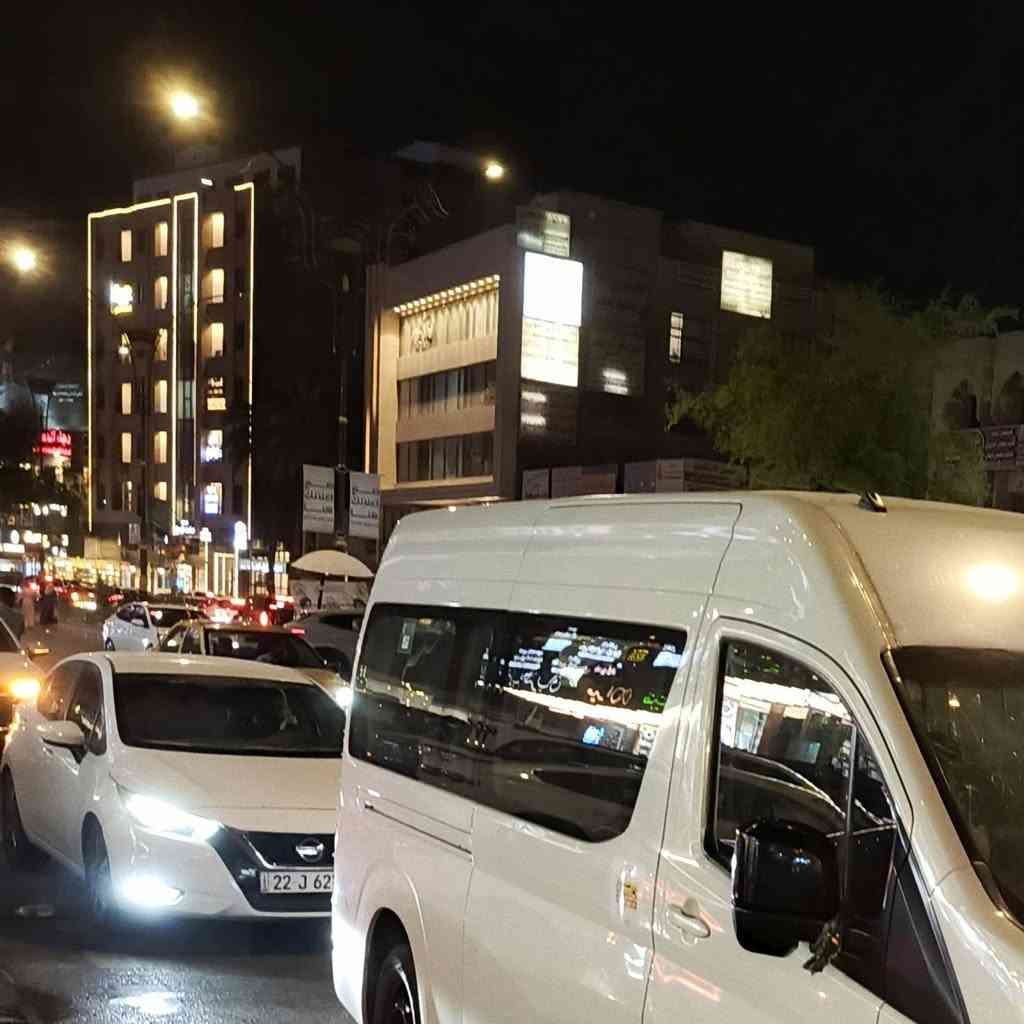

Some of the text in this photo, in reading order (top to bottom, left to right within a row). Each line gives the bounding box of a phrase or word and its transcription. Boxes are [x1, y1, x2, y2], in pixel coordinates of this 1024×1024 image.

[273, 874, 334, 890] 22 J 62
